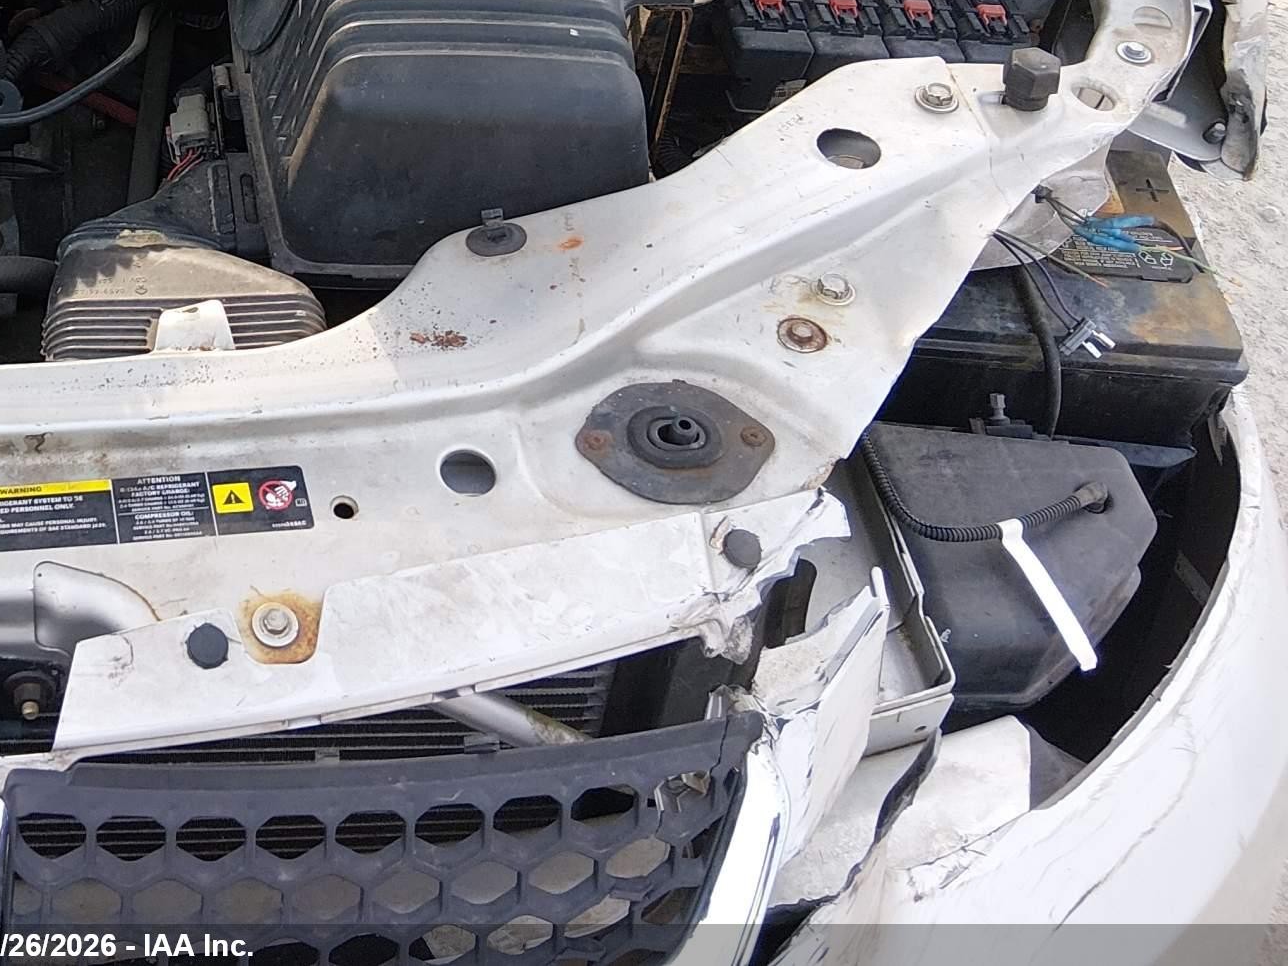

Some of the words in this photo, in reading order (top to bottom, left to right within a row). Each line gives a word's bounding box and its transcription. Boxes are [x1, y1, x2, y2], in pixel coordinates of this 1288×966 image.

[137, 475, 181, 485] ATTENTION
[157, 481, 200, 490] REFRIGERANT
[0, 486, 42, 495] WARNING
[33, 496, 62, 505] SYSTEM
[62, 495, 73, 503] TO
[10, 504, 53, 514] PERSONNEL
[134, 511, 180, 520] COMPRESSOR
